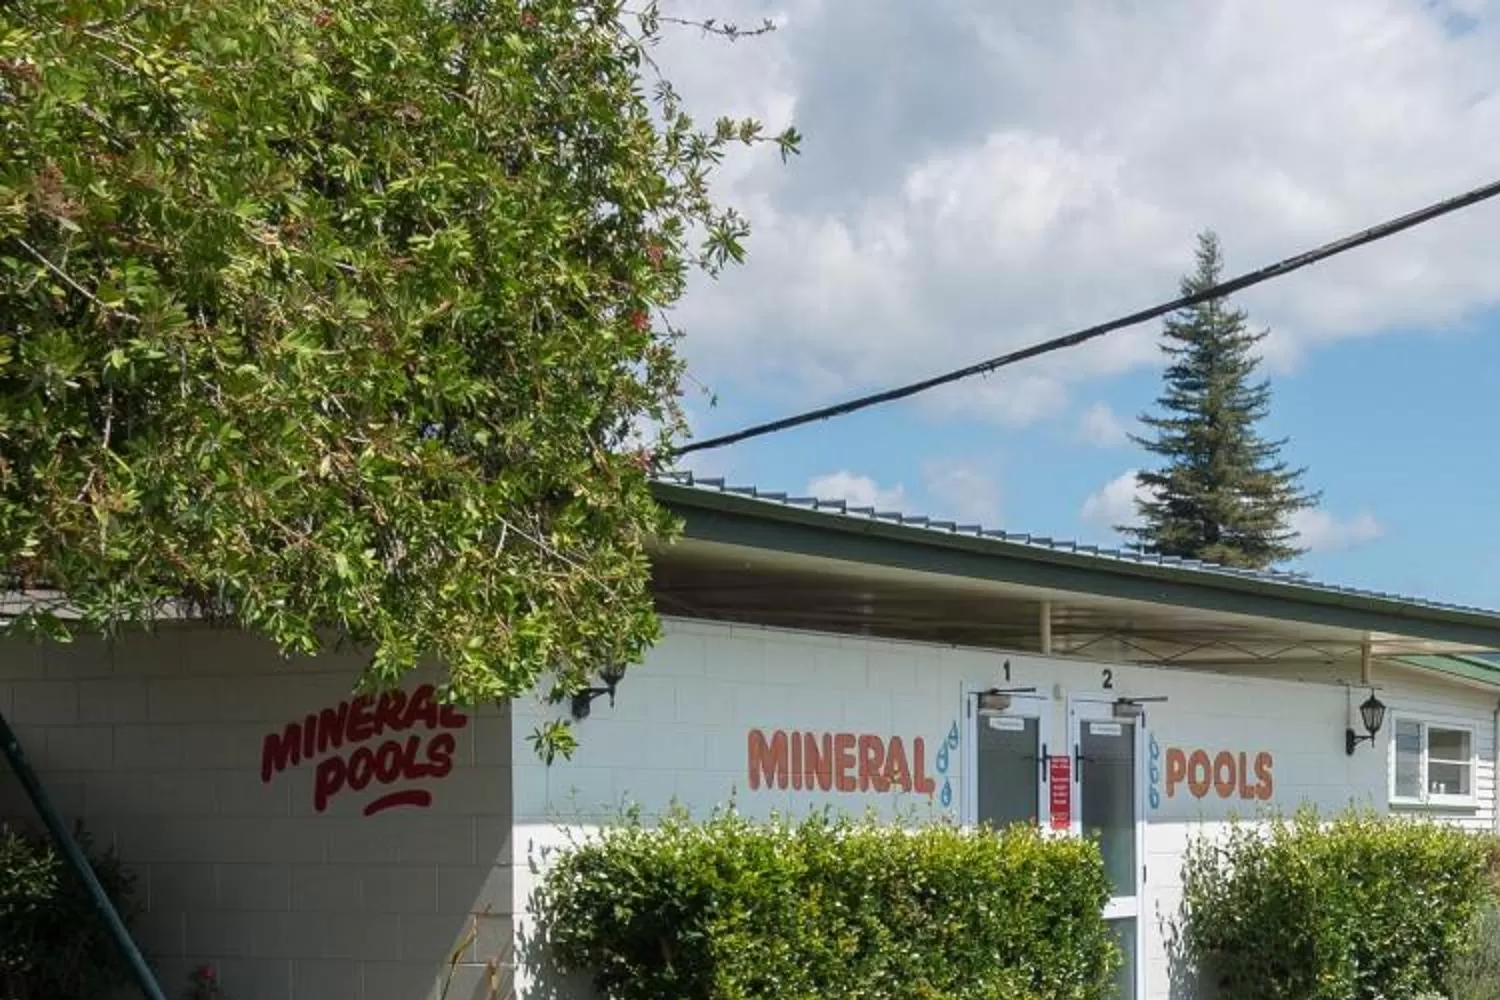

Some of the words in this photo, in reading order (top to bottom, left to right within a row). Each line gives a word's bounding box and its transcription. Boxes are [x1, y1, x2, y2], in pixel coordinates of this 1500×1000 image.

[1003, 659, 1011, 682] 1
[1102, 669, 1113, 689] 2
[261, 684, 468, 783] MINERAL
[748, 729, 936, 795] MINERAL
[314, 733, 456, 812] POOLS
[1166, 747, 1273, 801] POOLS
